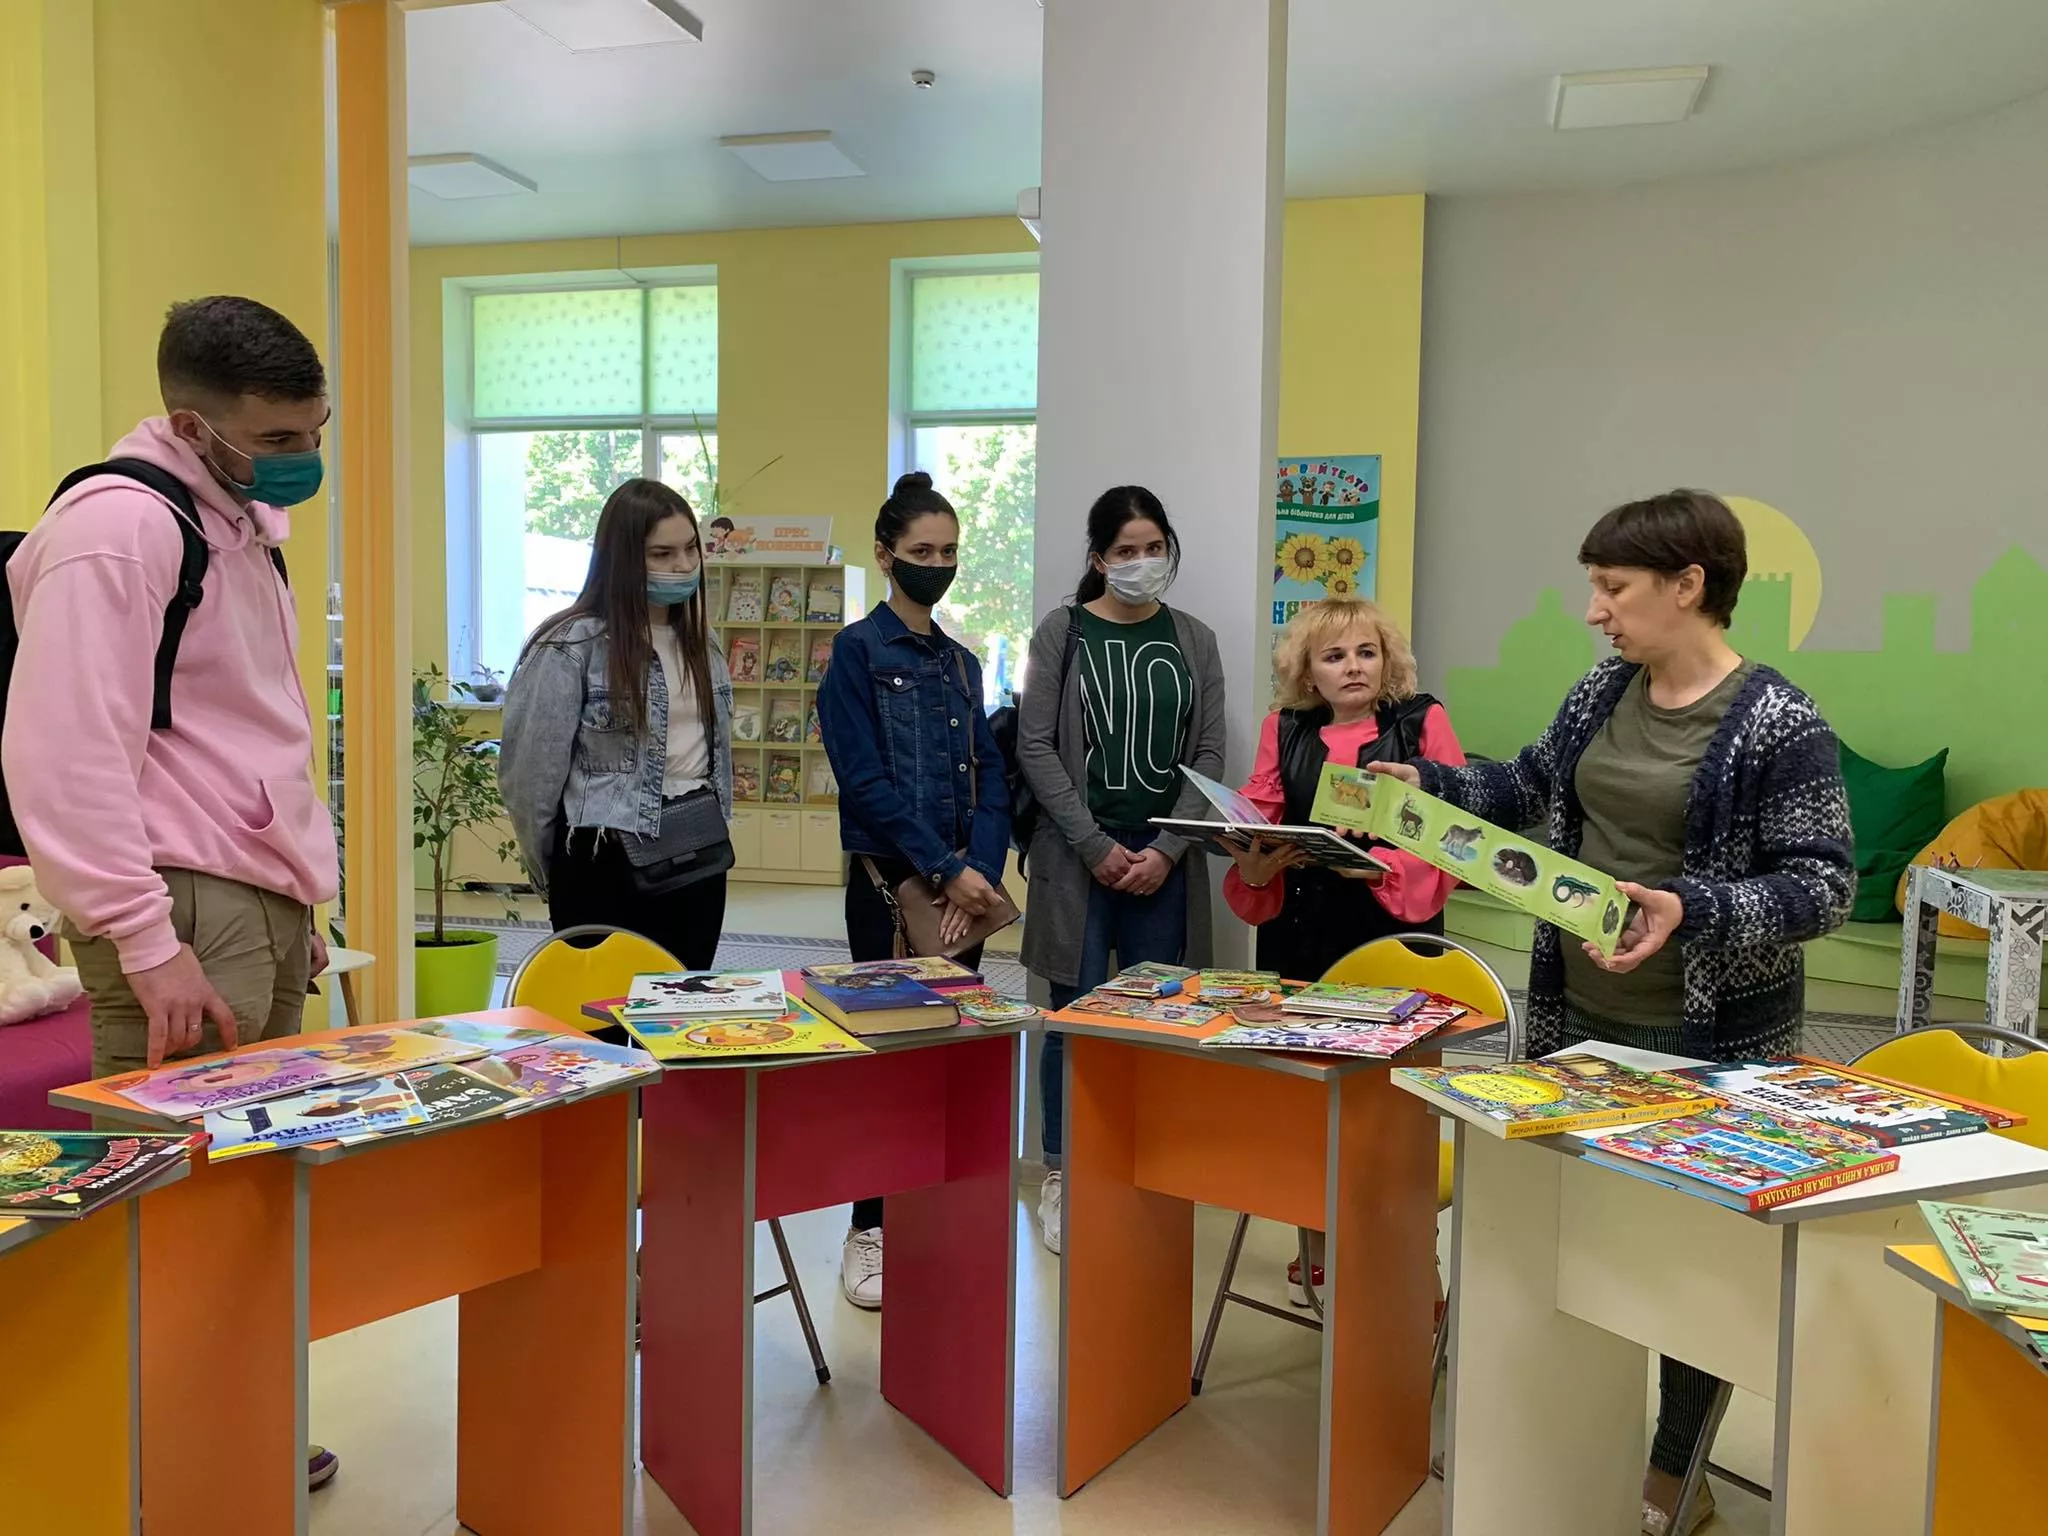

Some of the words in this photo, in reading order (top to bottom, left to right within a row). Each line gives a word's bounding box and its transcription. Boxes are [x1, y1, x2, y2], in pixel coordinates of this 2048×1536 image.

[1277, 462, 1328, 479] КОВИЙ
[85, 1152, 157, 1189] ЧАРІВНИЙ
[1862, 1160, 1896, 1181] ВЕЛИКА
[1804, 1173, 1833, 1195] ЦІКАВІ
[1758, 1184, 1803, 1207] ЗНАХІДКИ
